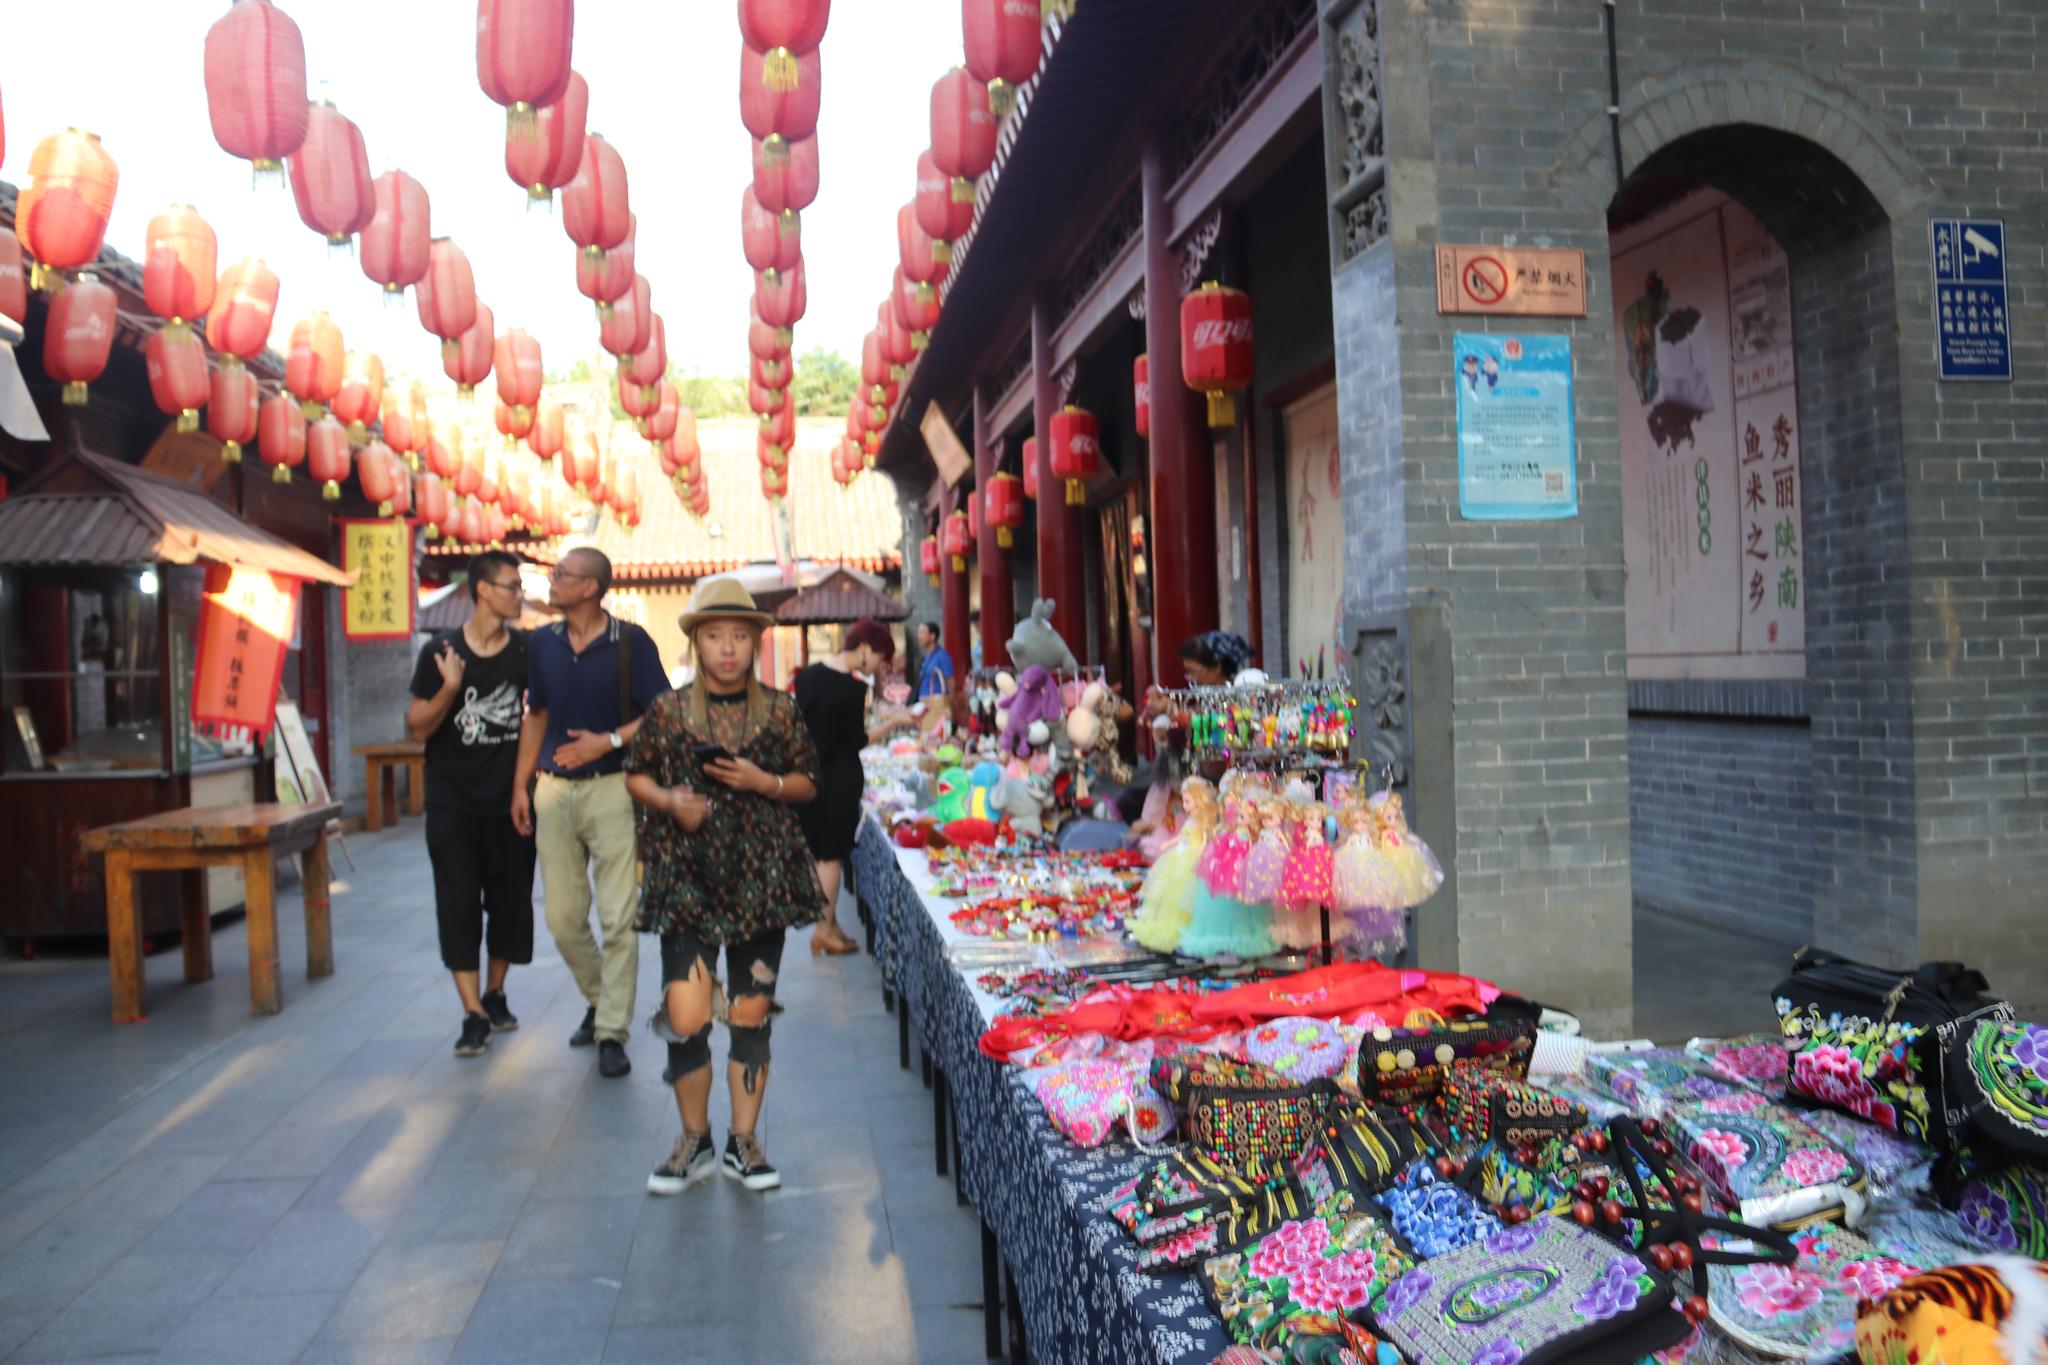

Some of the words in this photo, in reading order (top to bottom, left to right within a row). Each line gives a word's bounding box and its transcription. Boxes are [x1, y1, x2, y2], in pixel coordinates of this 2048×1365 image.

[1515, 267, 1576, 287] 严禁烟火
[1743, 420, 1769, 614] 鱼米之乡
[1772, 412, 1798, 609] 秀丽陕南
